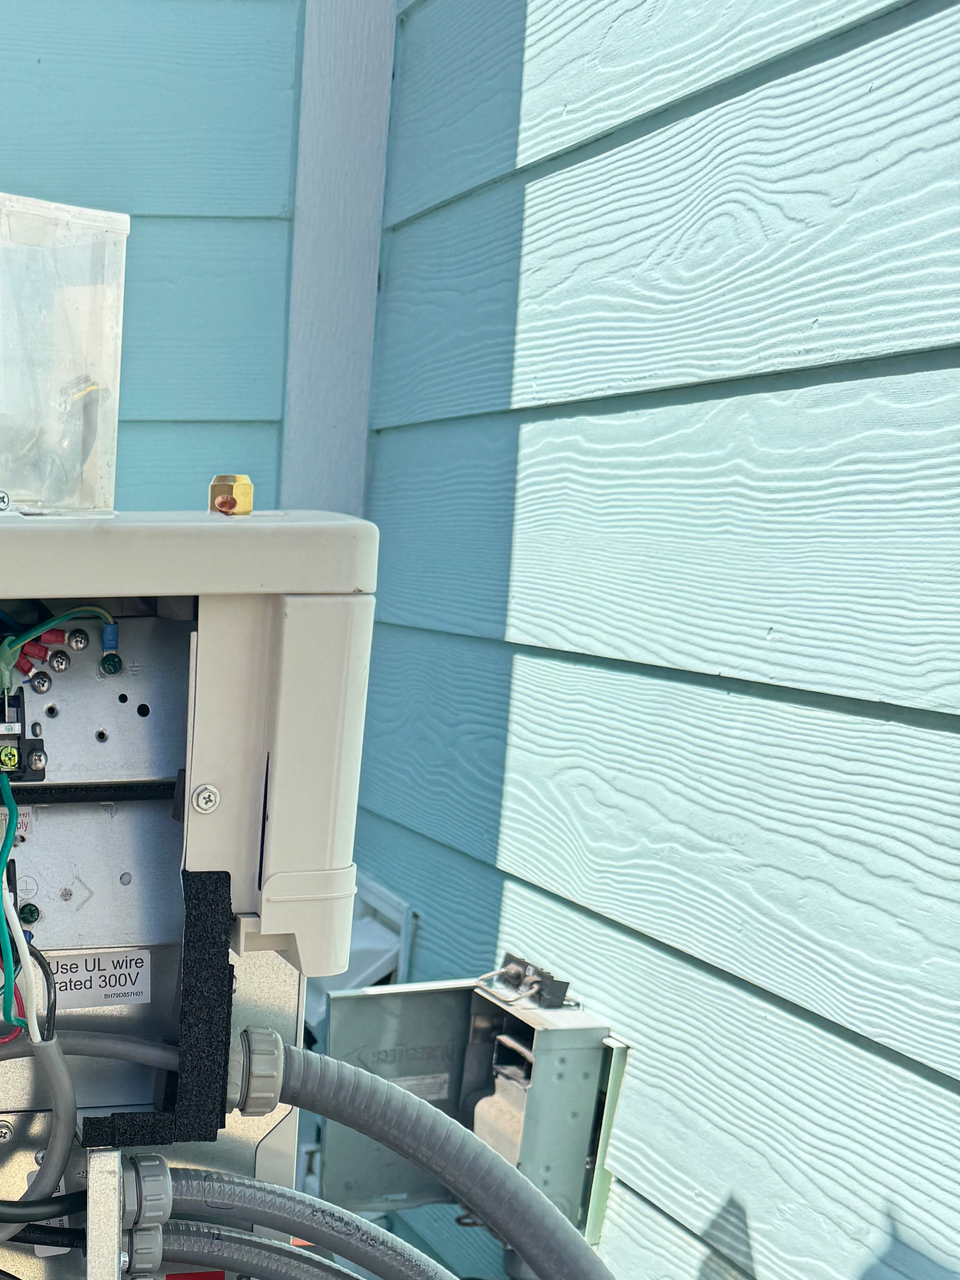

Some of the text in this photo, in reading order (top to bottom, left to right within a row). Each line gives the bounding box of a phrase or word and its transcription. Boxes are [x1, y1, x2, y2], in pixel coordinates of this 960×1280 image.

[48, 956, 144, 975] Use UL wire
[54, 972, 140, 992] rated 300V
